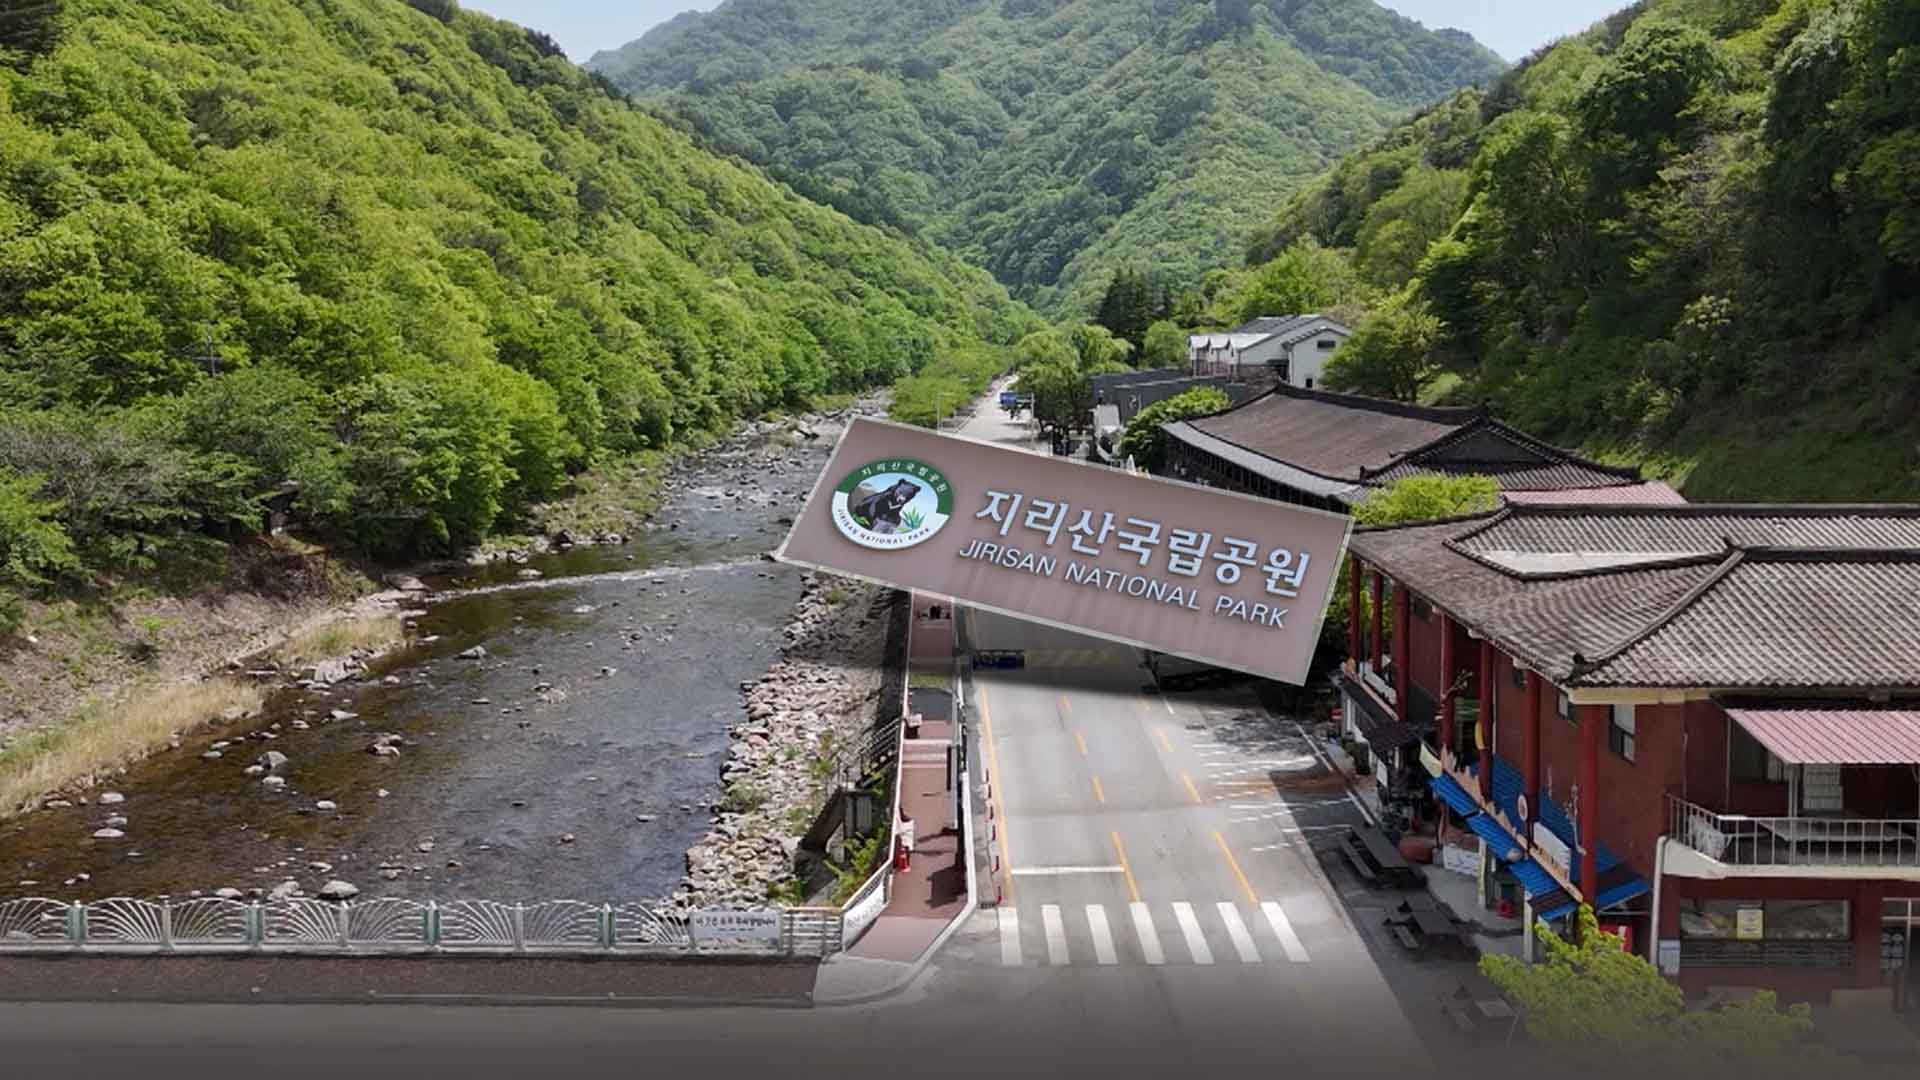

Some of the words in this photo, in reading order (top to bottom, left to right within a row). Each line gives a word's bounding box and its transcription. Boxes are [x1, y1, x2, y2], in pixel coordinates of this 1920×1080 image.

[959, 540, 1057, 577] JIRISAN
[1065, 561, 1201, 611] NATIONAL
[1215, 594, 1289, 630] PARK
[975, 490, 1310, 597] 지리산국립공원
